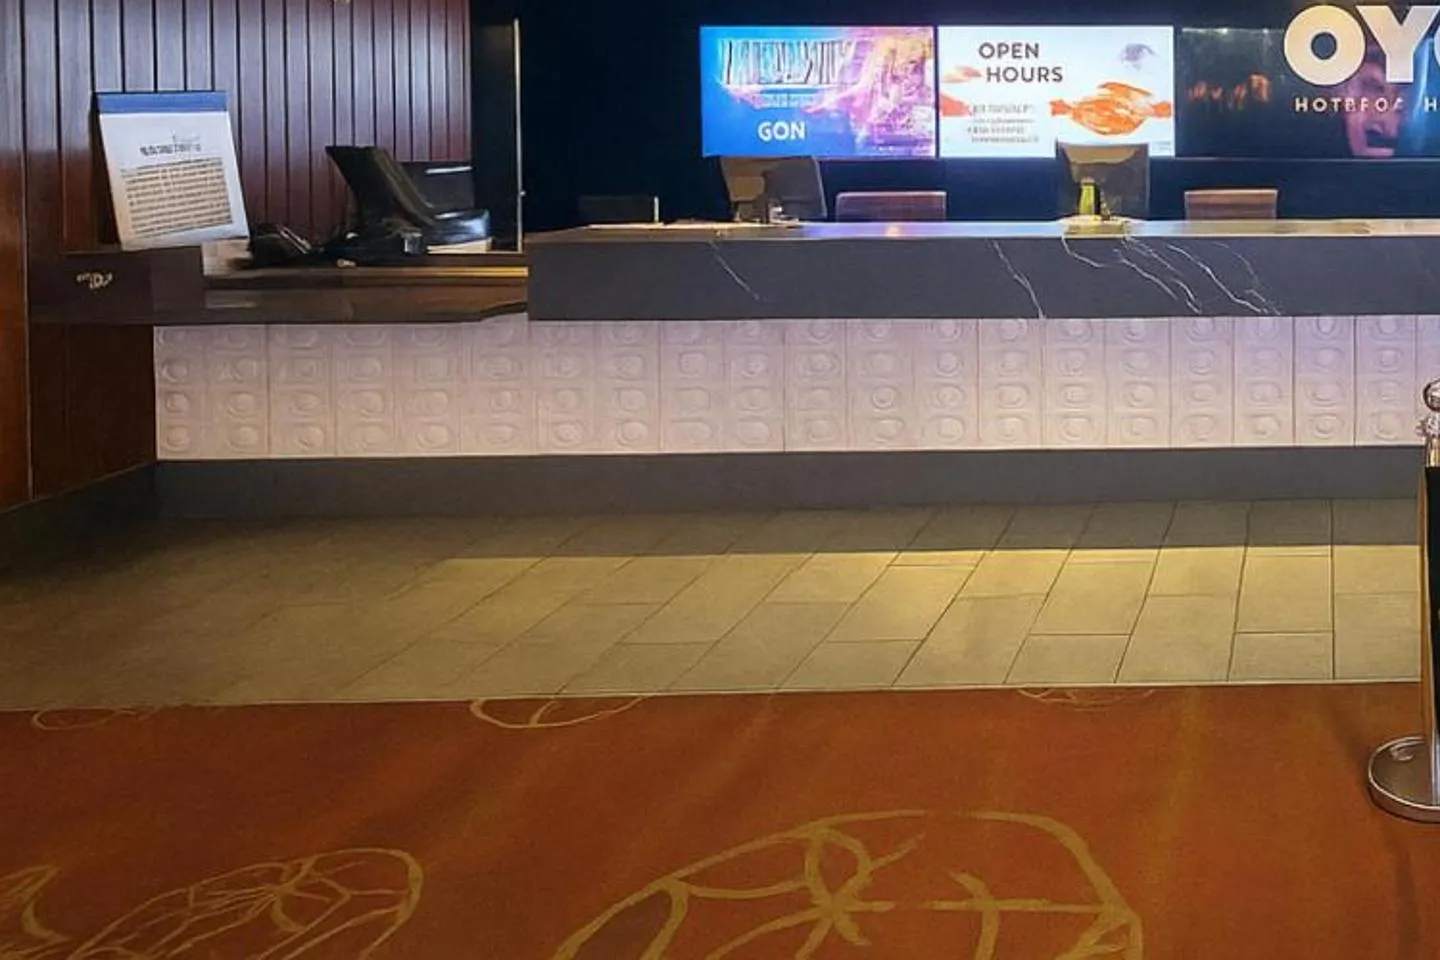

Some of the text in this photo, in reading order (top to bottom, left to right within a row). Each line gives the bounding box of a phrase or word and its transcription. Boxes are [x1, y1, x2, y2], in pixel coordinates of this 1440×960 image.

[978, 42, 1039, 59] OPEN
[986, 66, 1063, 83] HOURS
[758, 120, 806, 142] GON
